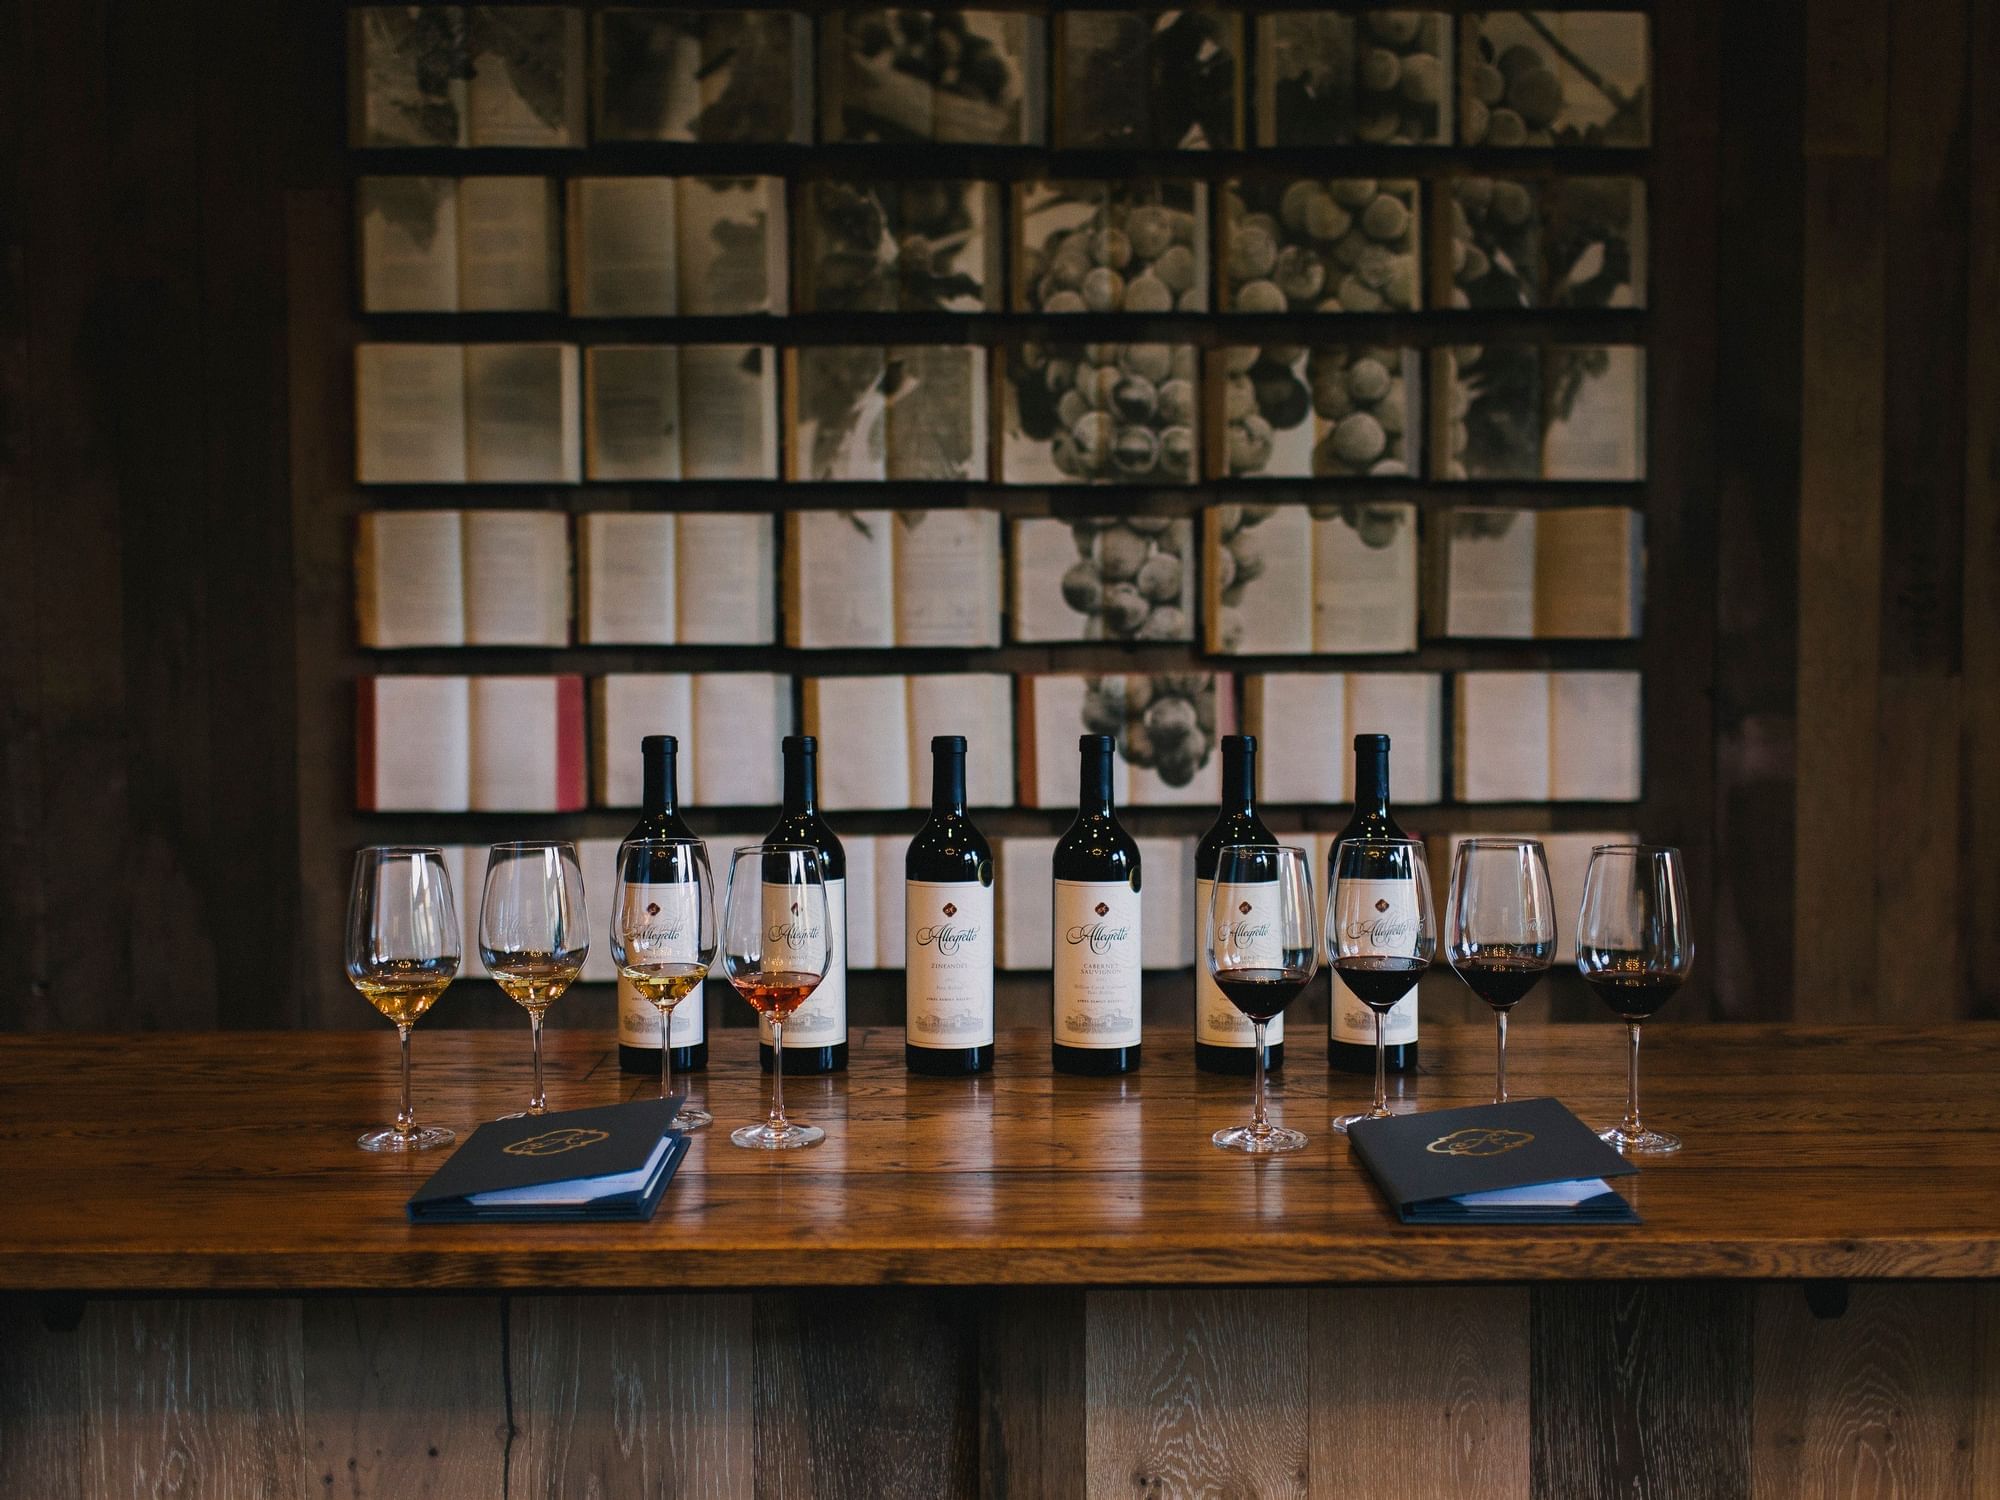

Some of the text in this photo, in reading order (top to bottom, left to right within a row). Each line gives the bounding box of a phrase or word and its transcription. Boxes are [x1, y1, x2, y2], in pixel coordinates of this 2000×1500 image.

[768, 923, 820, 950] Allegretto
[916, 923, 980, 956] Allegretto
[1066, 922, 1130, 955] Allegretto
[1217, 920, 1269, 949] Allegretto
